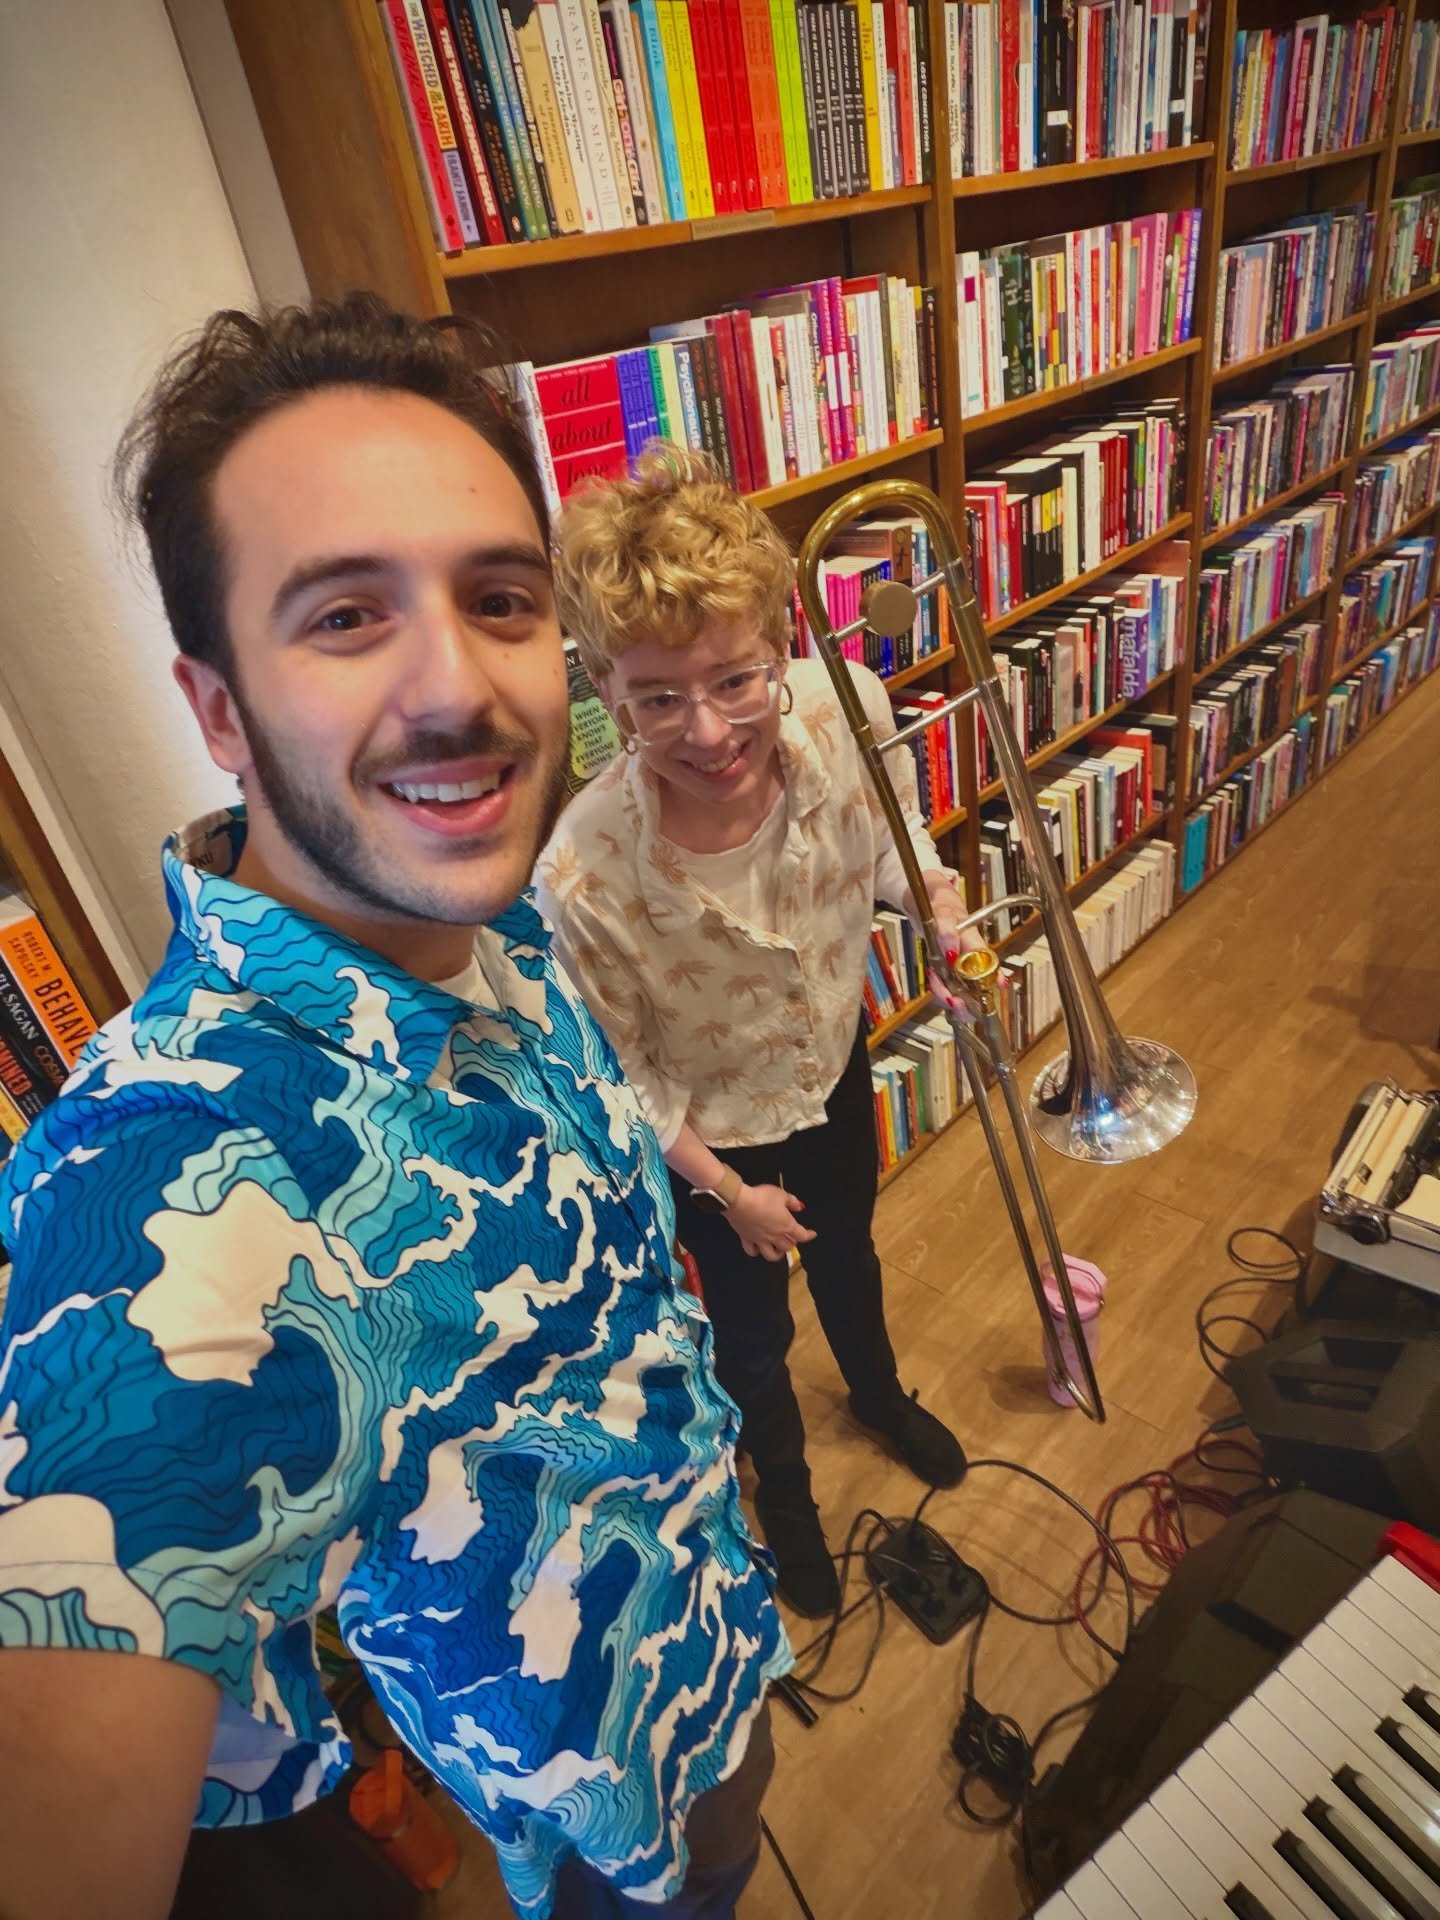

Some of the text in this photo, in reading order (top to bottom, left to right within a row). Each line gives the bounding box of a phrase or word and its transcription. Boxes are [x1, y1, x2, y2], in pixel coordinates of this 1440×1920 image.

[647, 26, 662, 68] Blink
[410, 17, 439, 88] WRETCHED
[431, 103, 454, 147] EARTH
[566, 5, 608, 179] RAMES OF MIND
[438, 27, 496, 216] THE TRANSGENDER ISSUE
[920, 86, 930, 152] CONNECTIONS
[612, 140, 625, 177] Mortal
[445, 152, 472, 221] FRANTZ FANON
[810, 311, 820, 344] Others
[562, 374, 590, 407] all
[678, 351, 701, 449] Psychonauts
[551, 416, 611, 451] about
[784, 413, 796, 458] FEMINISM
[1122, 618, 1139, 697] mafalda
[572, 713, 608, 731] VERYONE
[574, 705, 600, 720] WHEN
[584, 736, 602, 747] THAT
[8, 937, 39, 979] SAPOLSKY
[23, 931, 46, 963] ROBERT
[5, 993, 39, 1040] SAGAN
[34, 978, 91, 1057] BEHAVE
[33, 1045, 64, 1085] COSM
